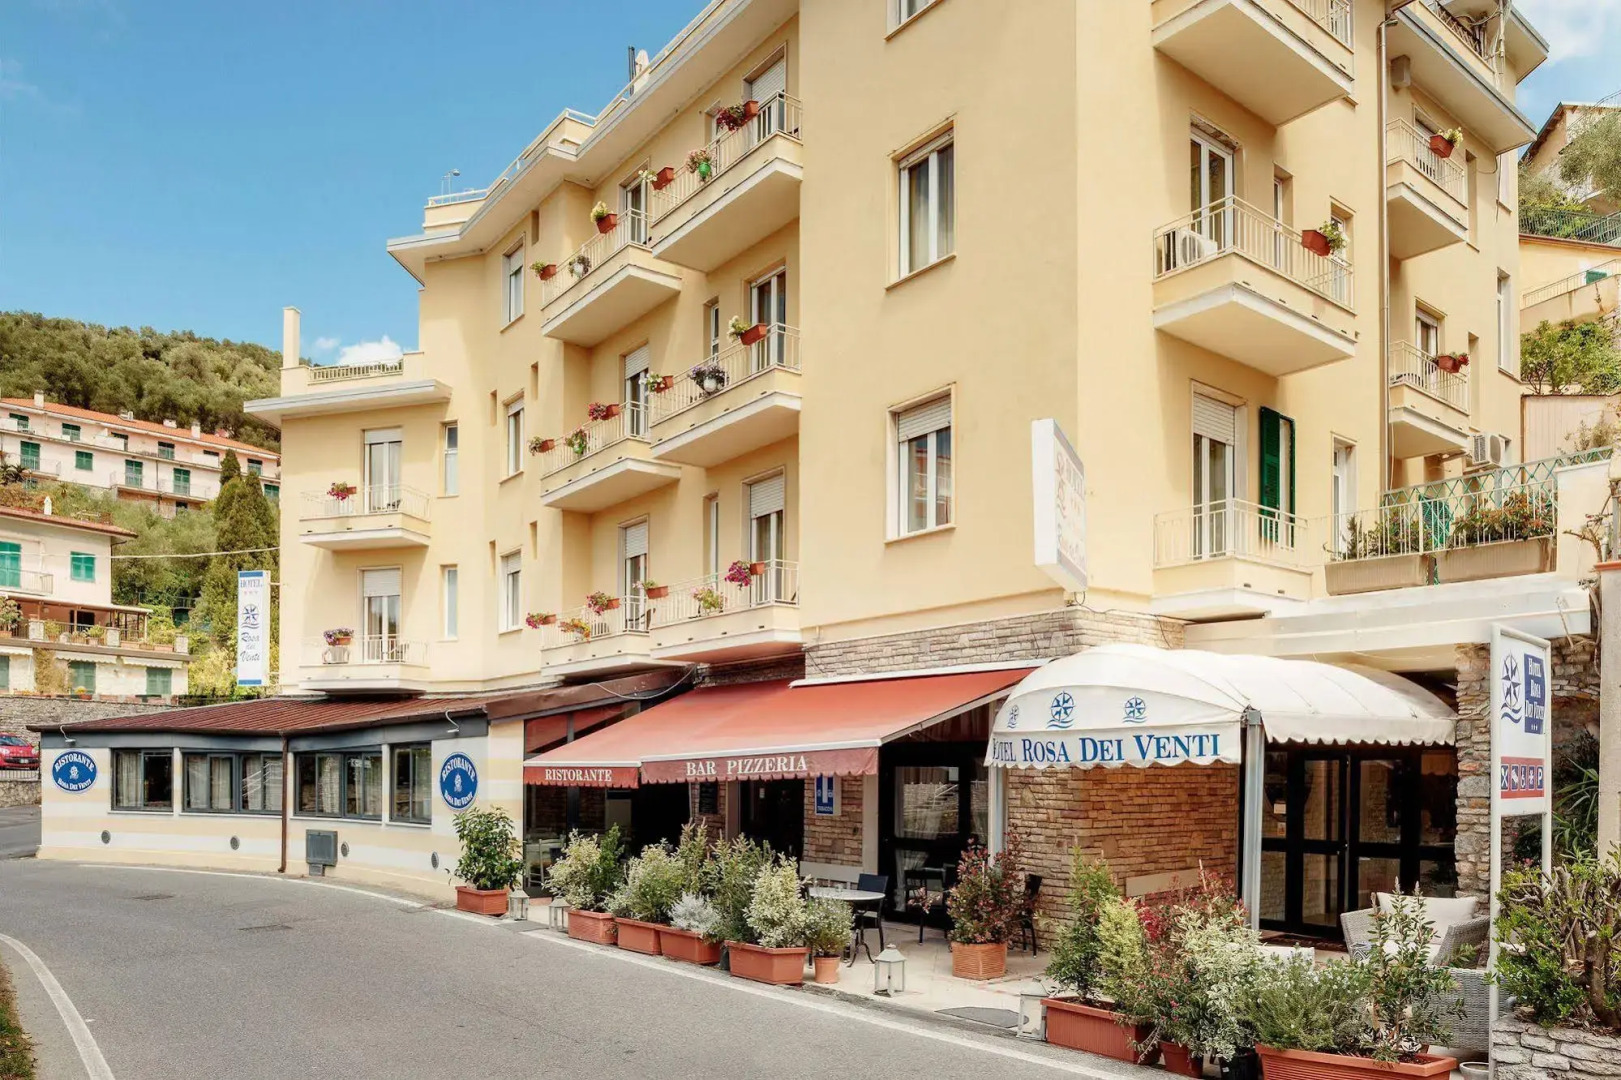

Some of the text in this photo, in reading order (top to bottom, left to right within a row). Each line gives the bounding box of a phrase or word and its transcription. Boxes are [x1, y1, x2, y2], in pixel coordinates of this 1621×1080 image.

[240, 579, 263, 588] HOTEL
[1021, 738, 1071, 763] ROSA
[1079, 736, 1125, 762] DEI
[1133, 733, 1221, 760] VENTI
[54, 753, 95, 772] RISTORANTE
[686, 755, 808, 776] BAR PIZZERIA
[545, 769, 612, 781] RISTORANTE
[1537, 768, 1543, 786] P
